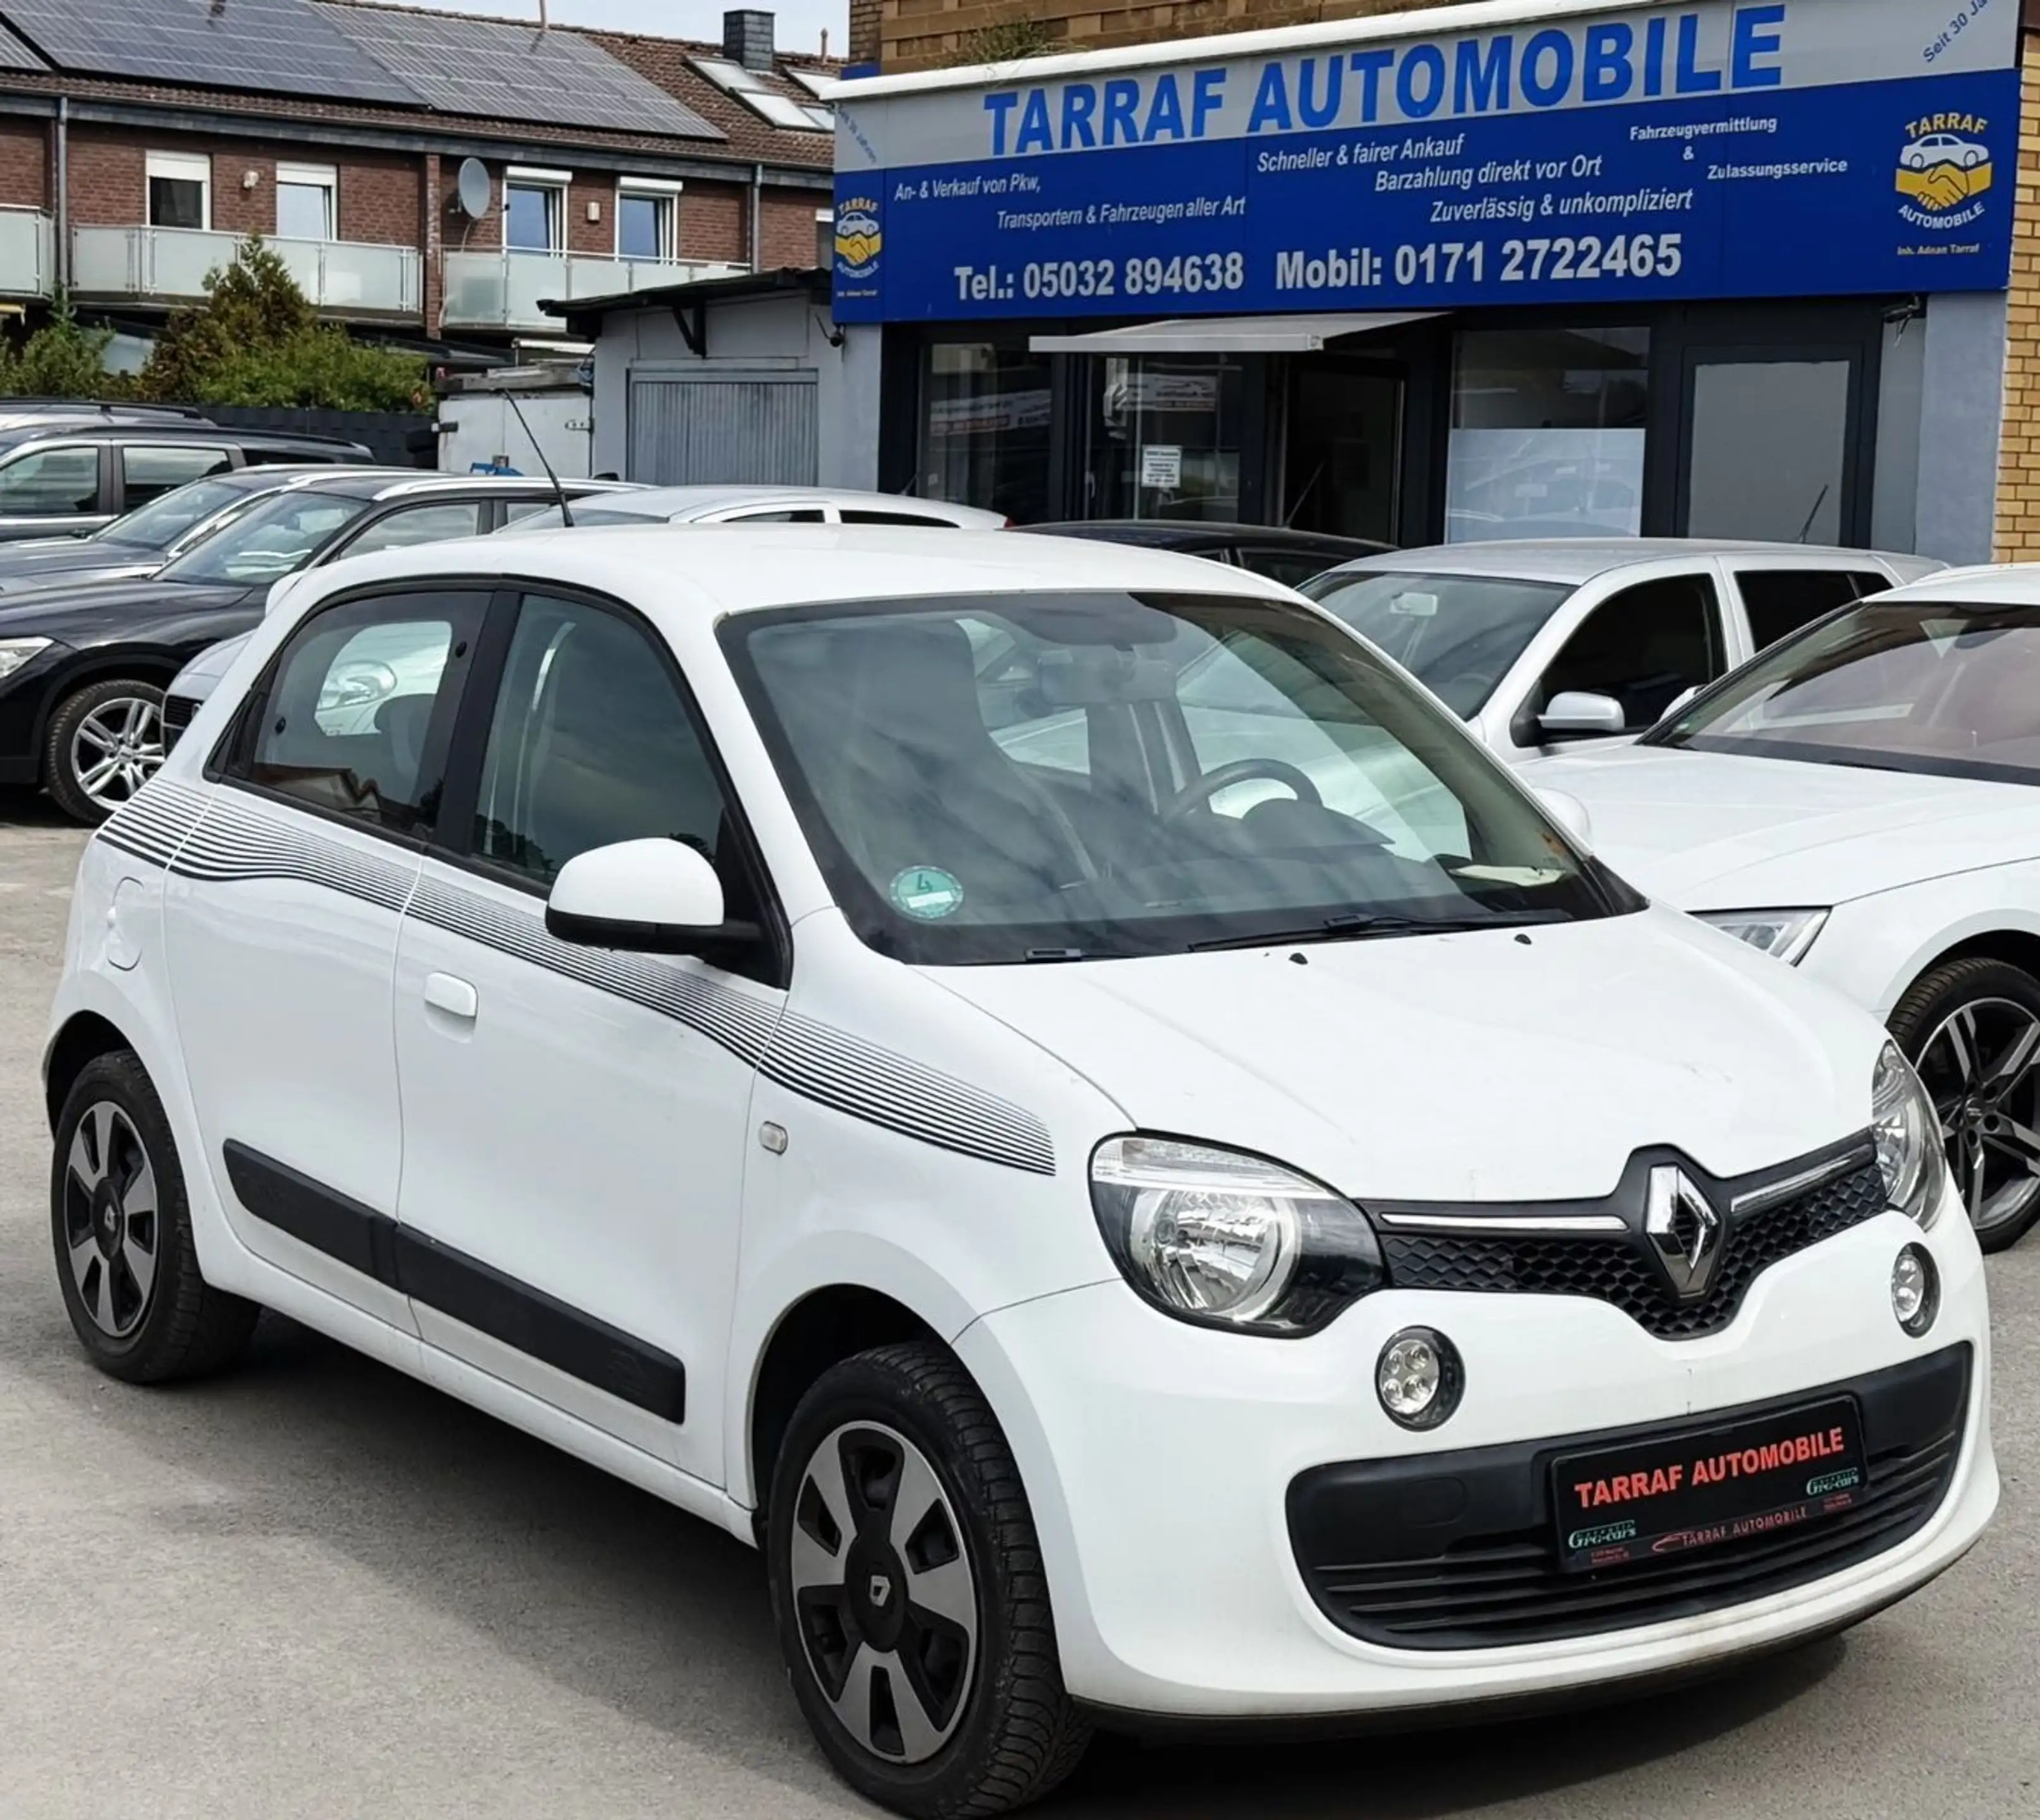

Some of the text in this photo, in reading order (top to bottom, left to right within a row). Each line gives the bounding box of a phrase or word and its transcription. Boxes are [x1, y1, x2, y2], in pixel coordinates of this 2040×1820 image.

[1922, 32, 1952, 63] Seit
[1949, 12, 1969, 35] 30
[983, 68, 1227, 157] TARRAF
[1246, 4, 1785, 133] AUTOMOBILE
[1629, 116, 1778, 141] Fahrzeugvermittlung
[1904, 112, 1988, 138] TARRAF
[1256, 133, 1466, 173] Schneller & fairer Ankauf
[1682, 145, 1695, 161] &
[1706, 157, 1848, 180] Zulassungsservice
[894, 173, 1041, 201] An- & Verkauf von Pkw,
[1375, 154, 1603, 191] Barzahlung direkt vor Ort
[997, 194, 1246, 231] Transportern & Fahrzeugen aller Art
[1430, 187, 1694, 222] Zuverlässig & unkompliziert
[1897, 201, 1986, 230] AUTOMOBILE
[954, 251, 1244, 300] Tel.: 05032 894638
[1276, 233, 1682, 290] Mobil: 0171 2722465
[917, 873, 933, 892] 4
[1574, 1427, 1845, 1509] TARRAF AUTOMOBILE
[1682, 1505, 1807, 1546] TARRAF AUTOMOBILE
